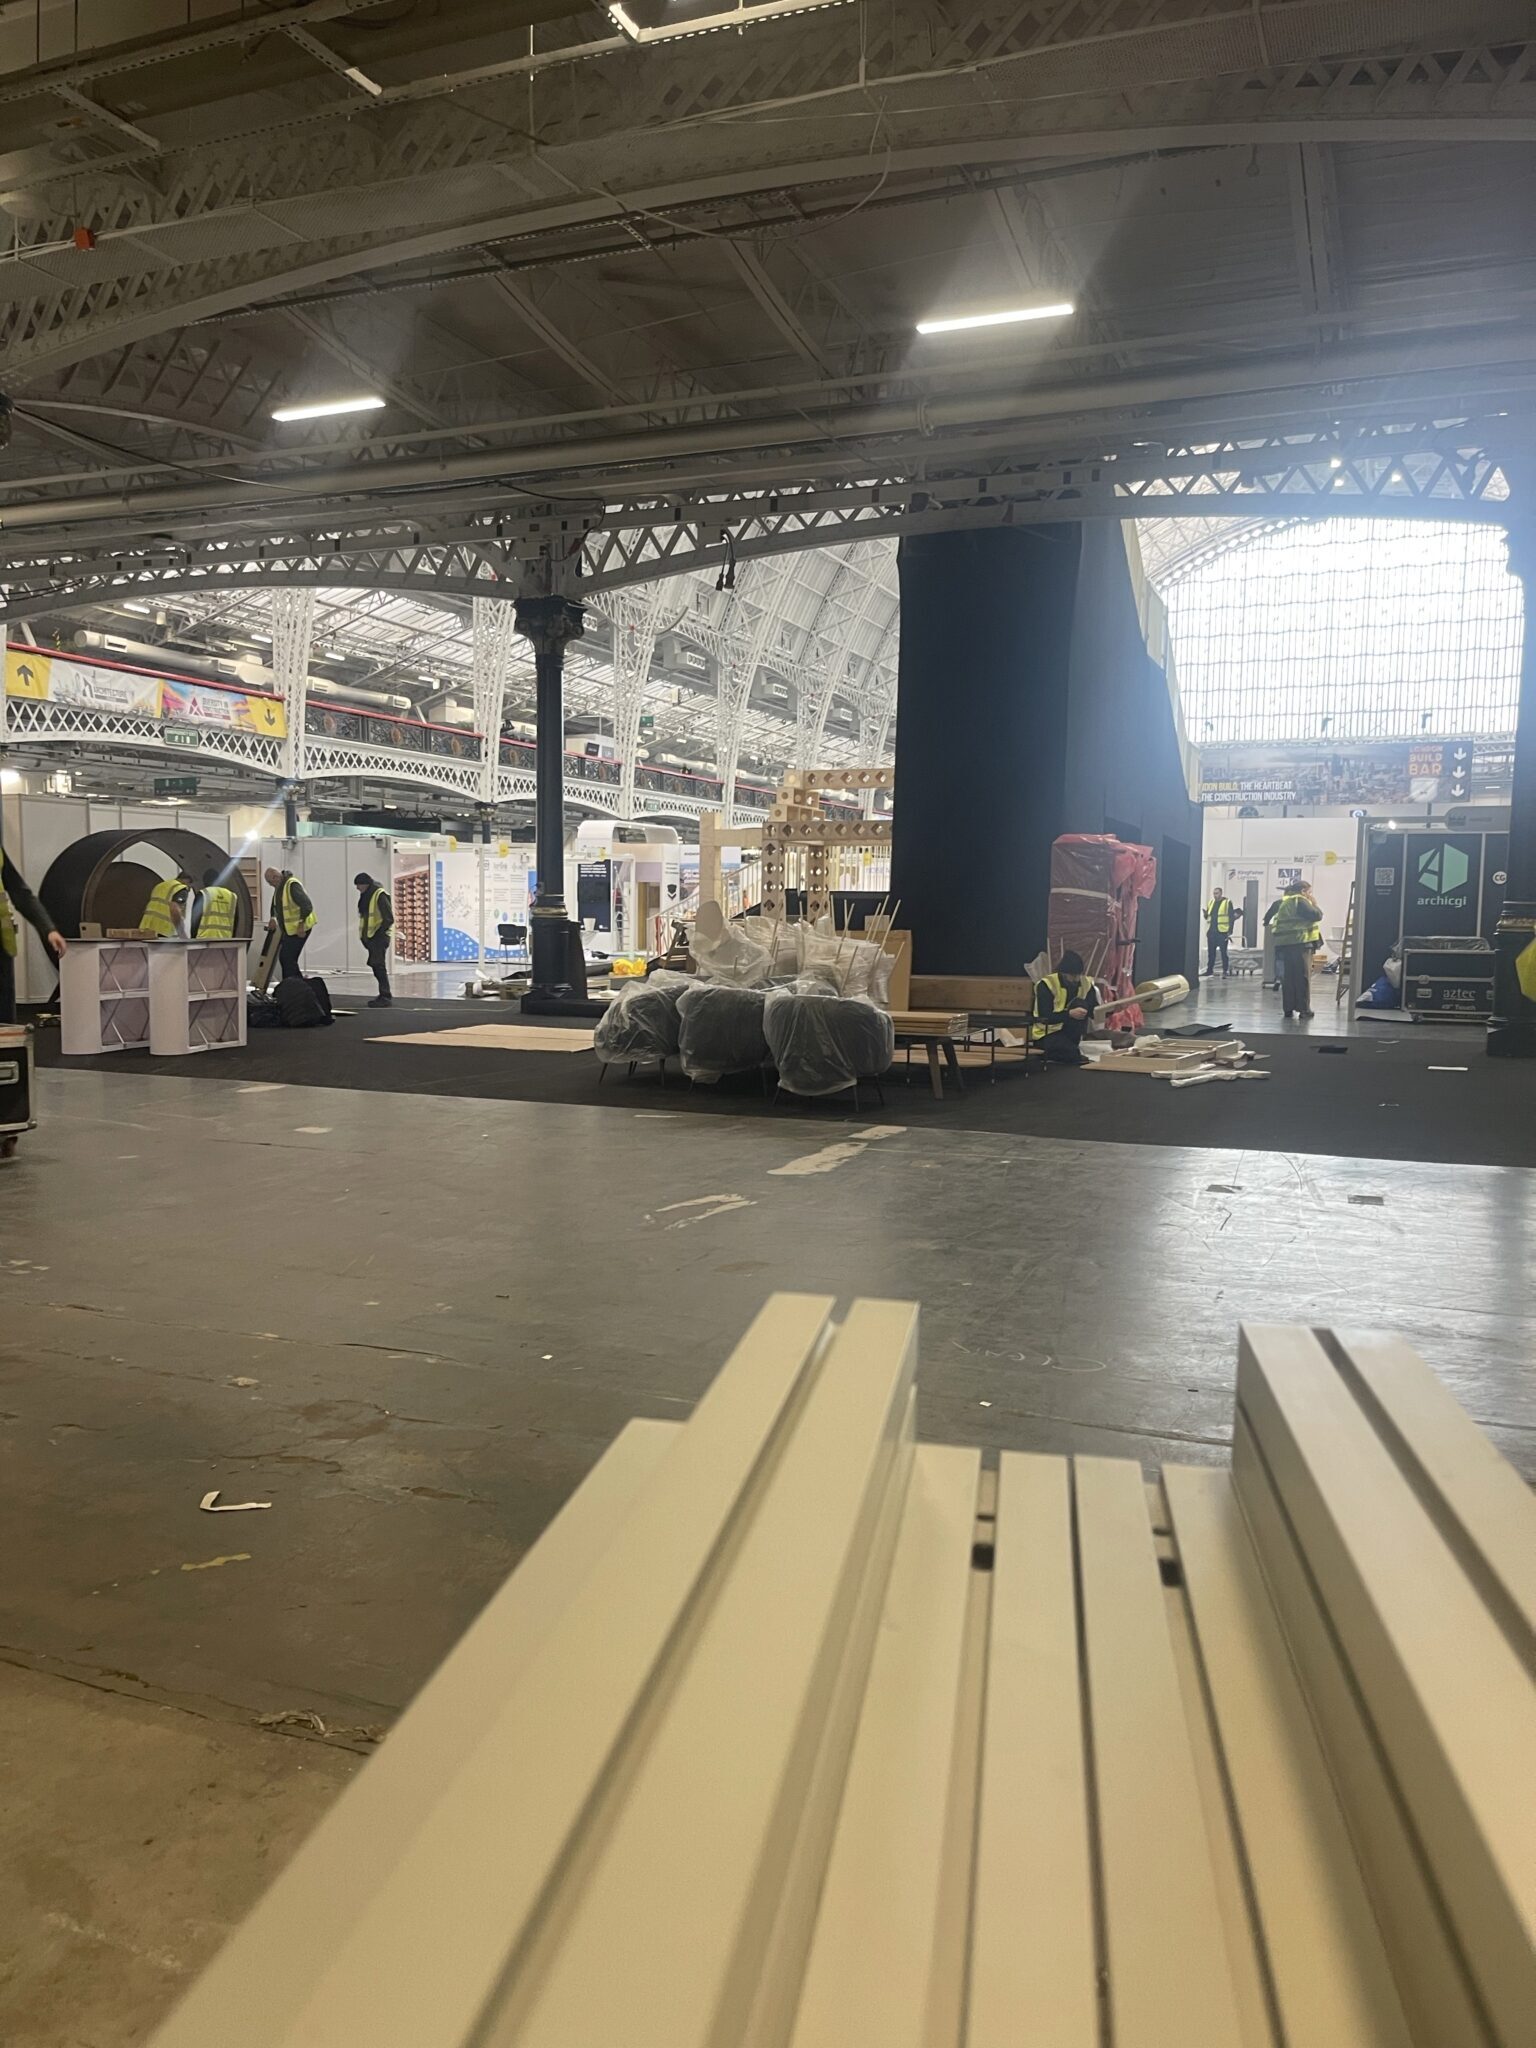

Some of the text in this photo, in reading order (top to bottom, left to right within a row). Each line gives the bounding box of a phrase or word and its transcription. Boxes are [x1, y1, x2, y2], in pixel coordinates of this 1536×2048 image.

[1409, 753, 1443, 762] BUILD
[1409, 763, 1442, 775] BAR
[1240, 781, 1253, 790] THE
[1254, 781, 1292, 790] HEARTBEAT
[1215, 792, 1263, 801] CONSTRUCTION
[1264, 791, 1296, 801] INDUSTRY
[1443, 989, 1476, 998] aztec
